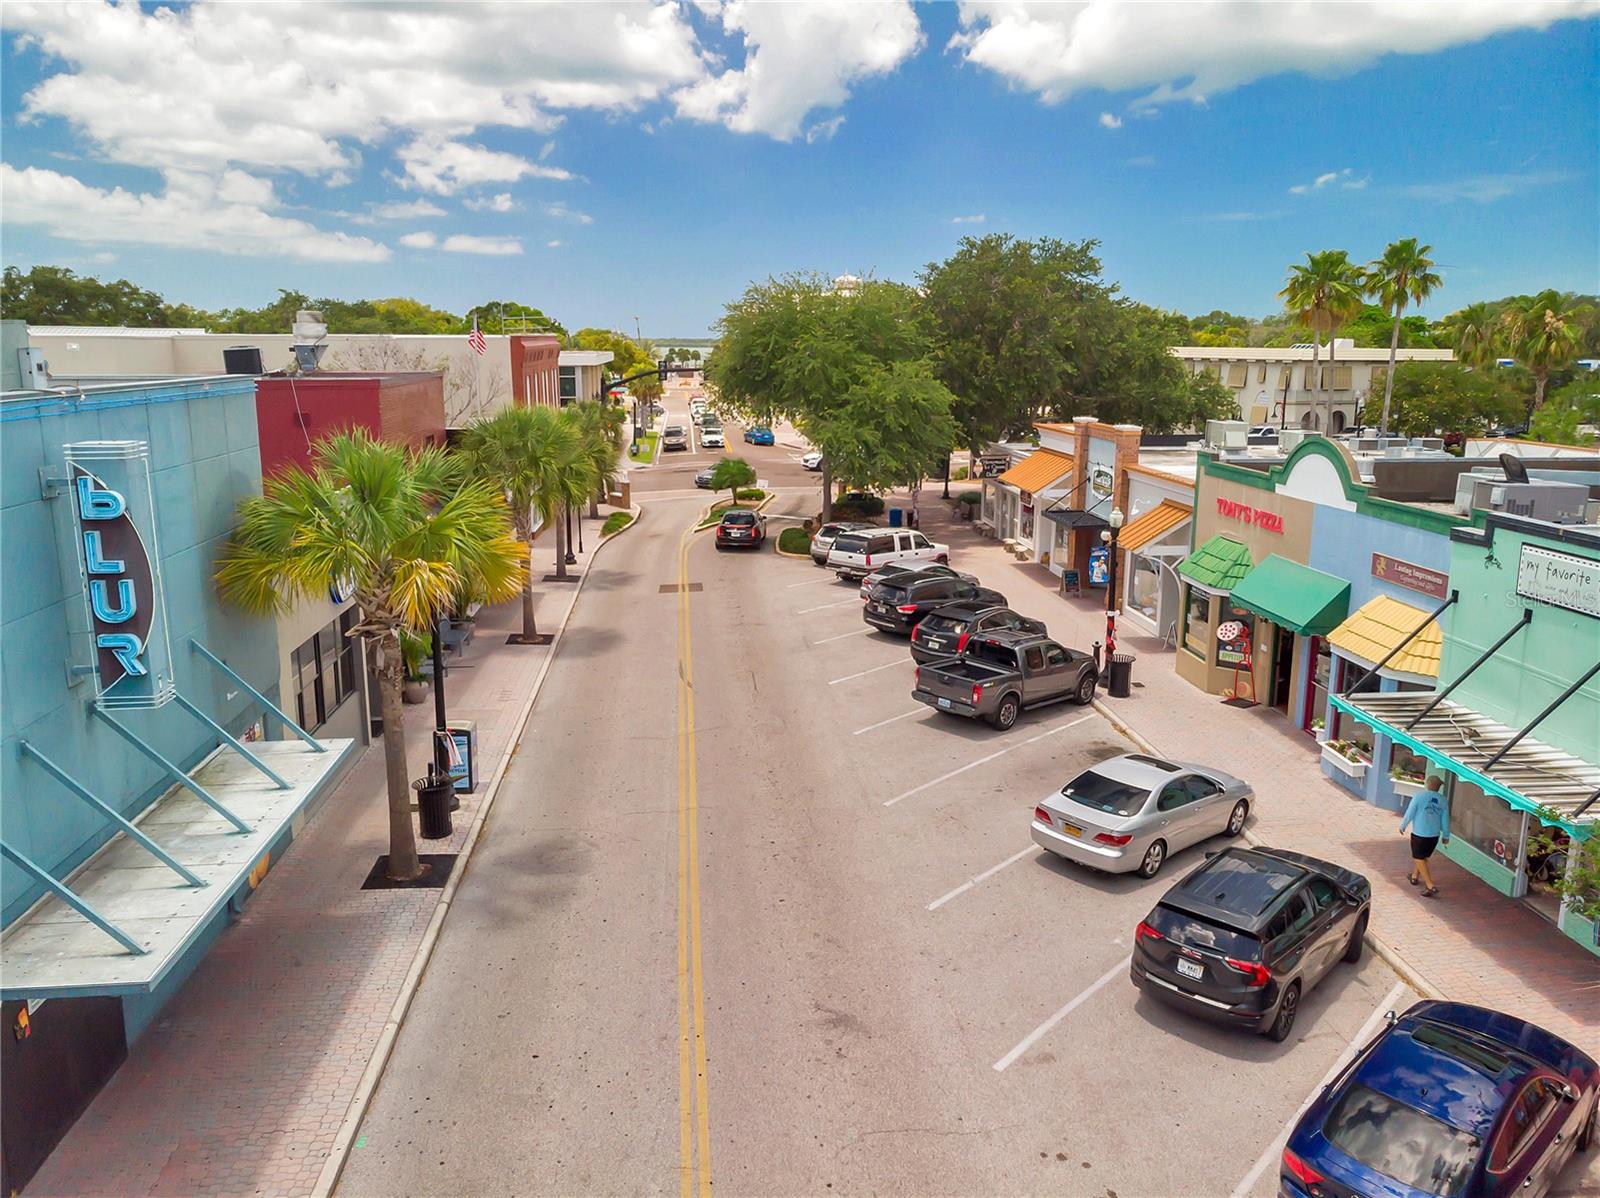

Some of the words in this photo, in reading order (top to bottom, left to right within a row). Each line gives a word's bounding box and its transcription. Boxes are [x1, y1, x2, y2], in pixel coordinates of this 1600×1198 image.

[1216, 496, 1252, 525] TONY'S
[1253, 508, 1285, 535] PIZZA
[1394, 562, 1413, 576] Lasting
[1412, 568, 1443, 585] Impressions
[1526, 560, 1540, 579] my
[1546, 561, 1591, 587] favorite
